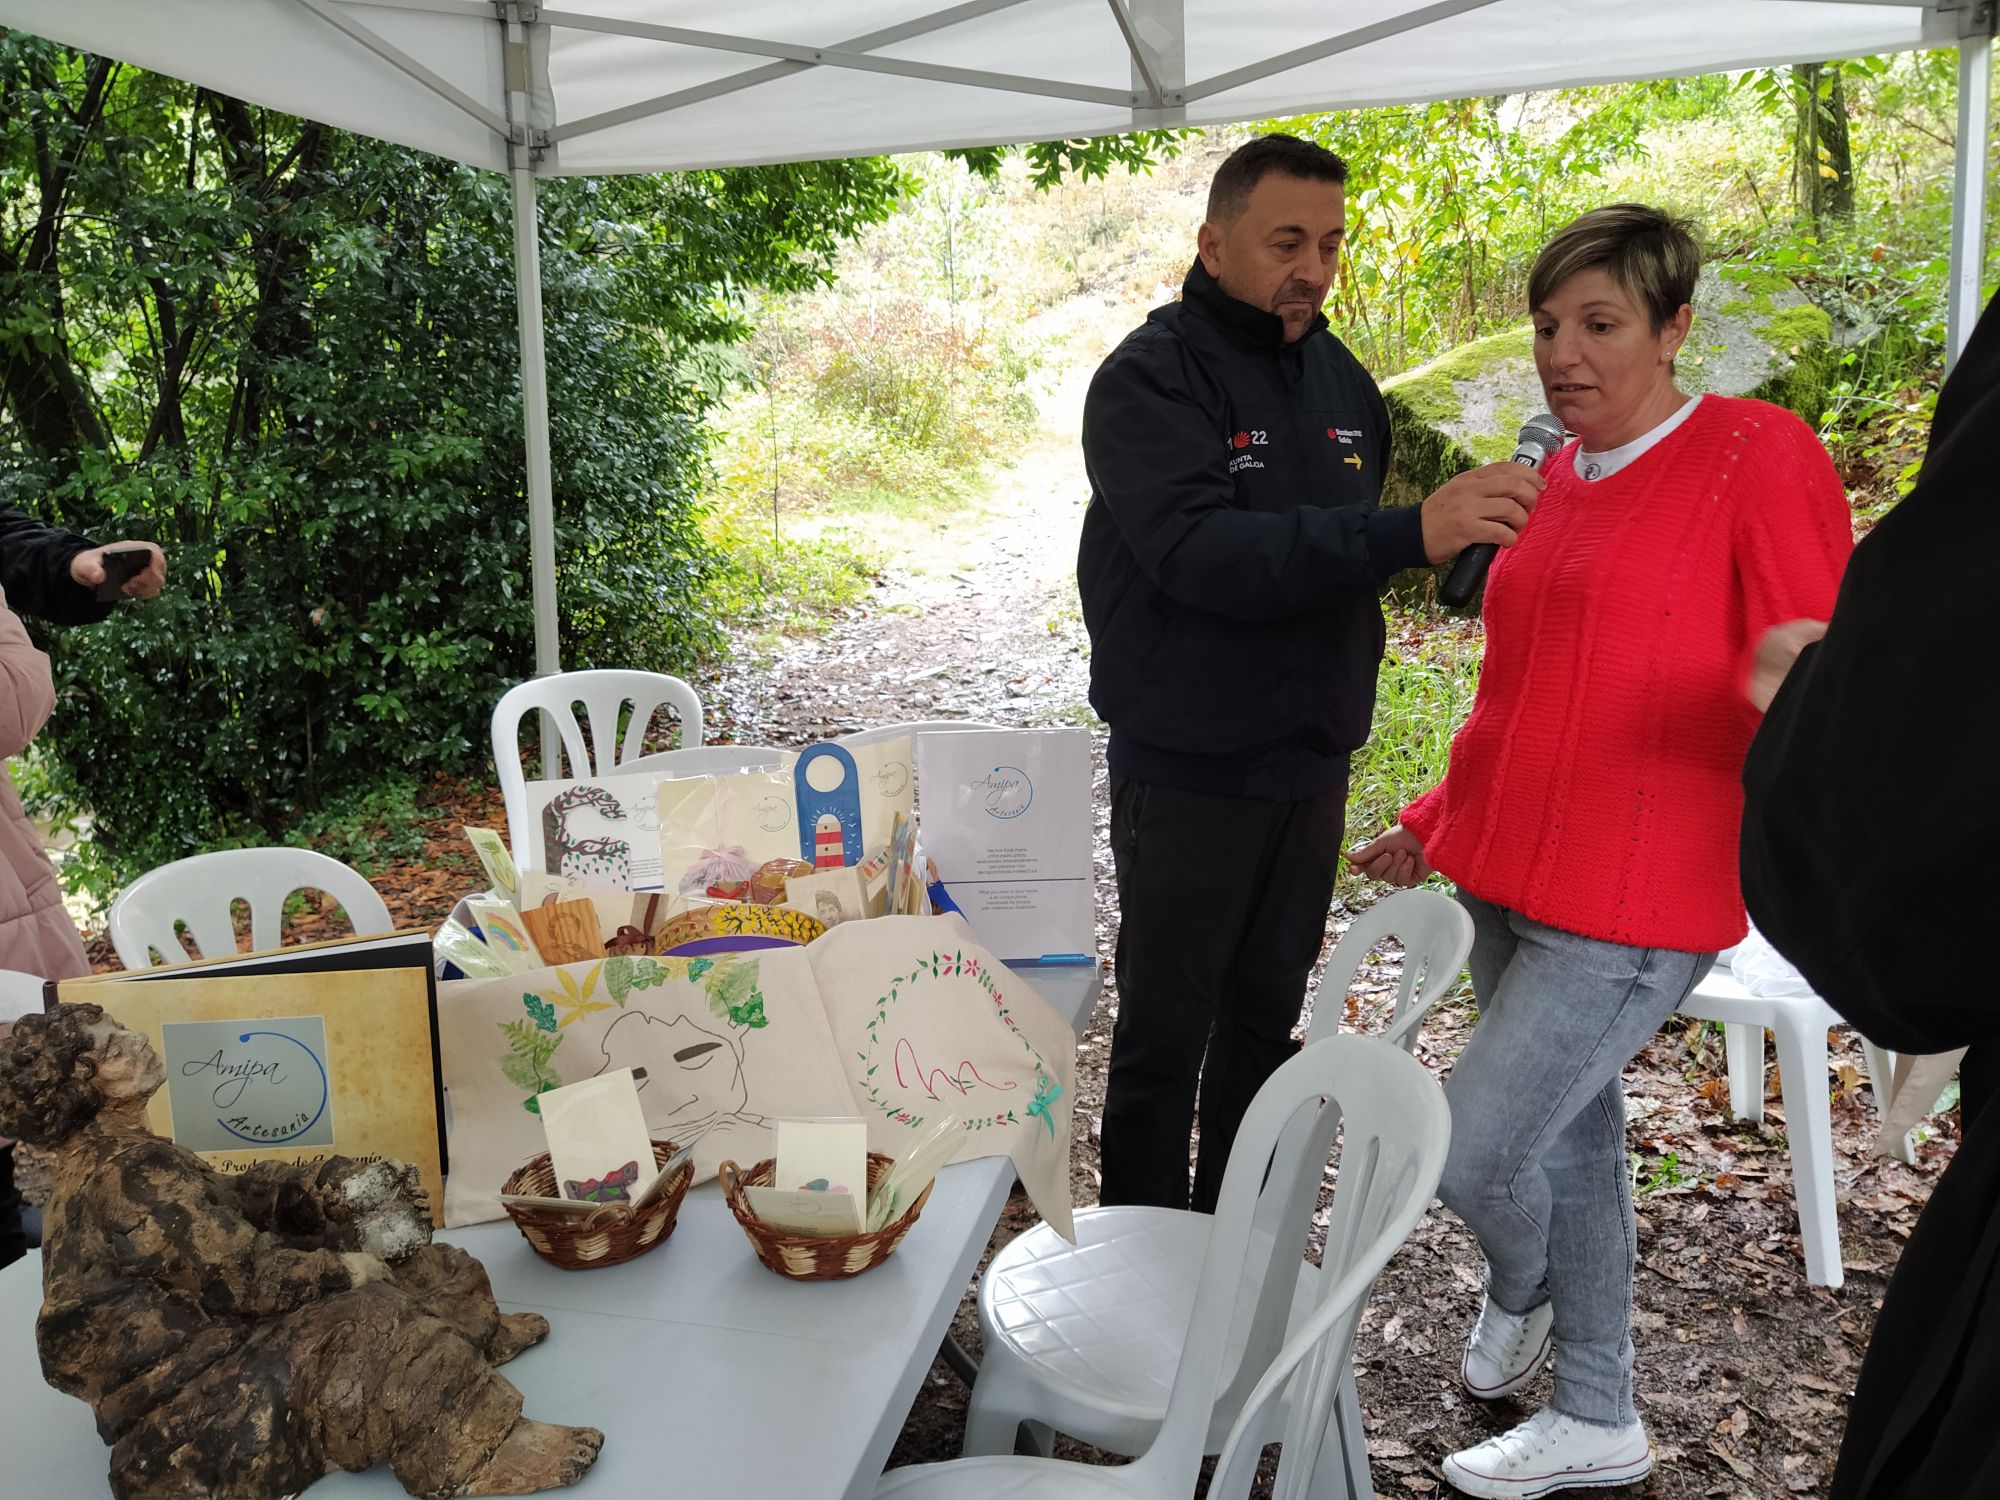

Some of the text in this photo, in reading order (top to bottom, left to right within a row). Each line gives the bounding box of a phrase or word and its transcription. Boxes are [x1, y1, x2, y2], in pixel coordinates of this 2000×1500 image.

[1250, 430, 1269, 445] 22
[1230, 464, 1239, 473] DE
[182, 1049, 288, 1109] Amipa
